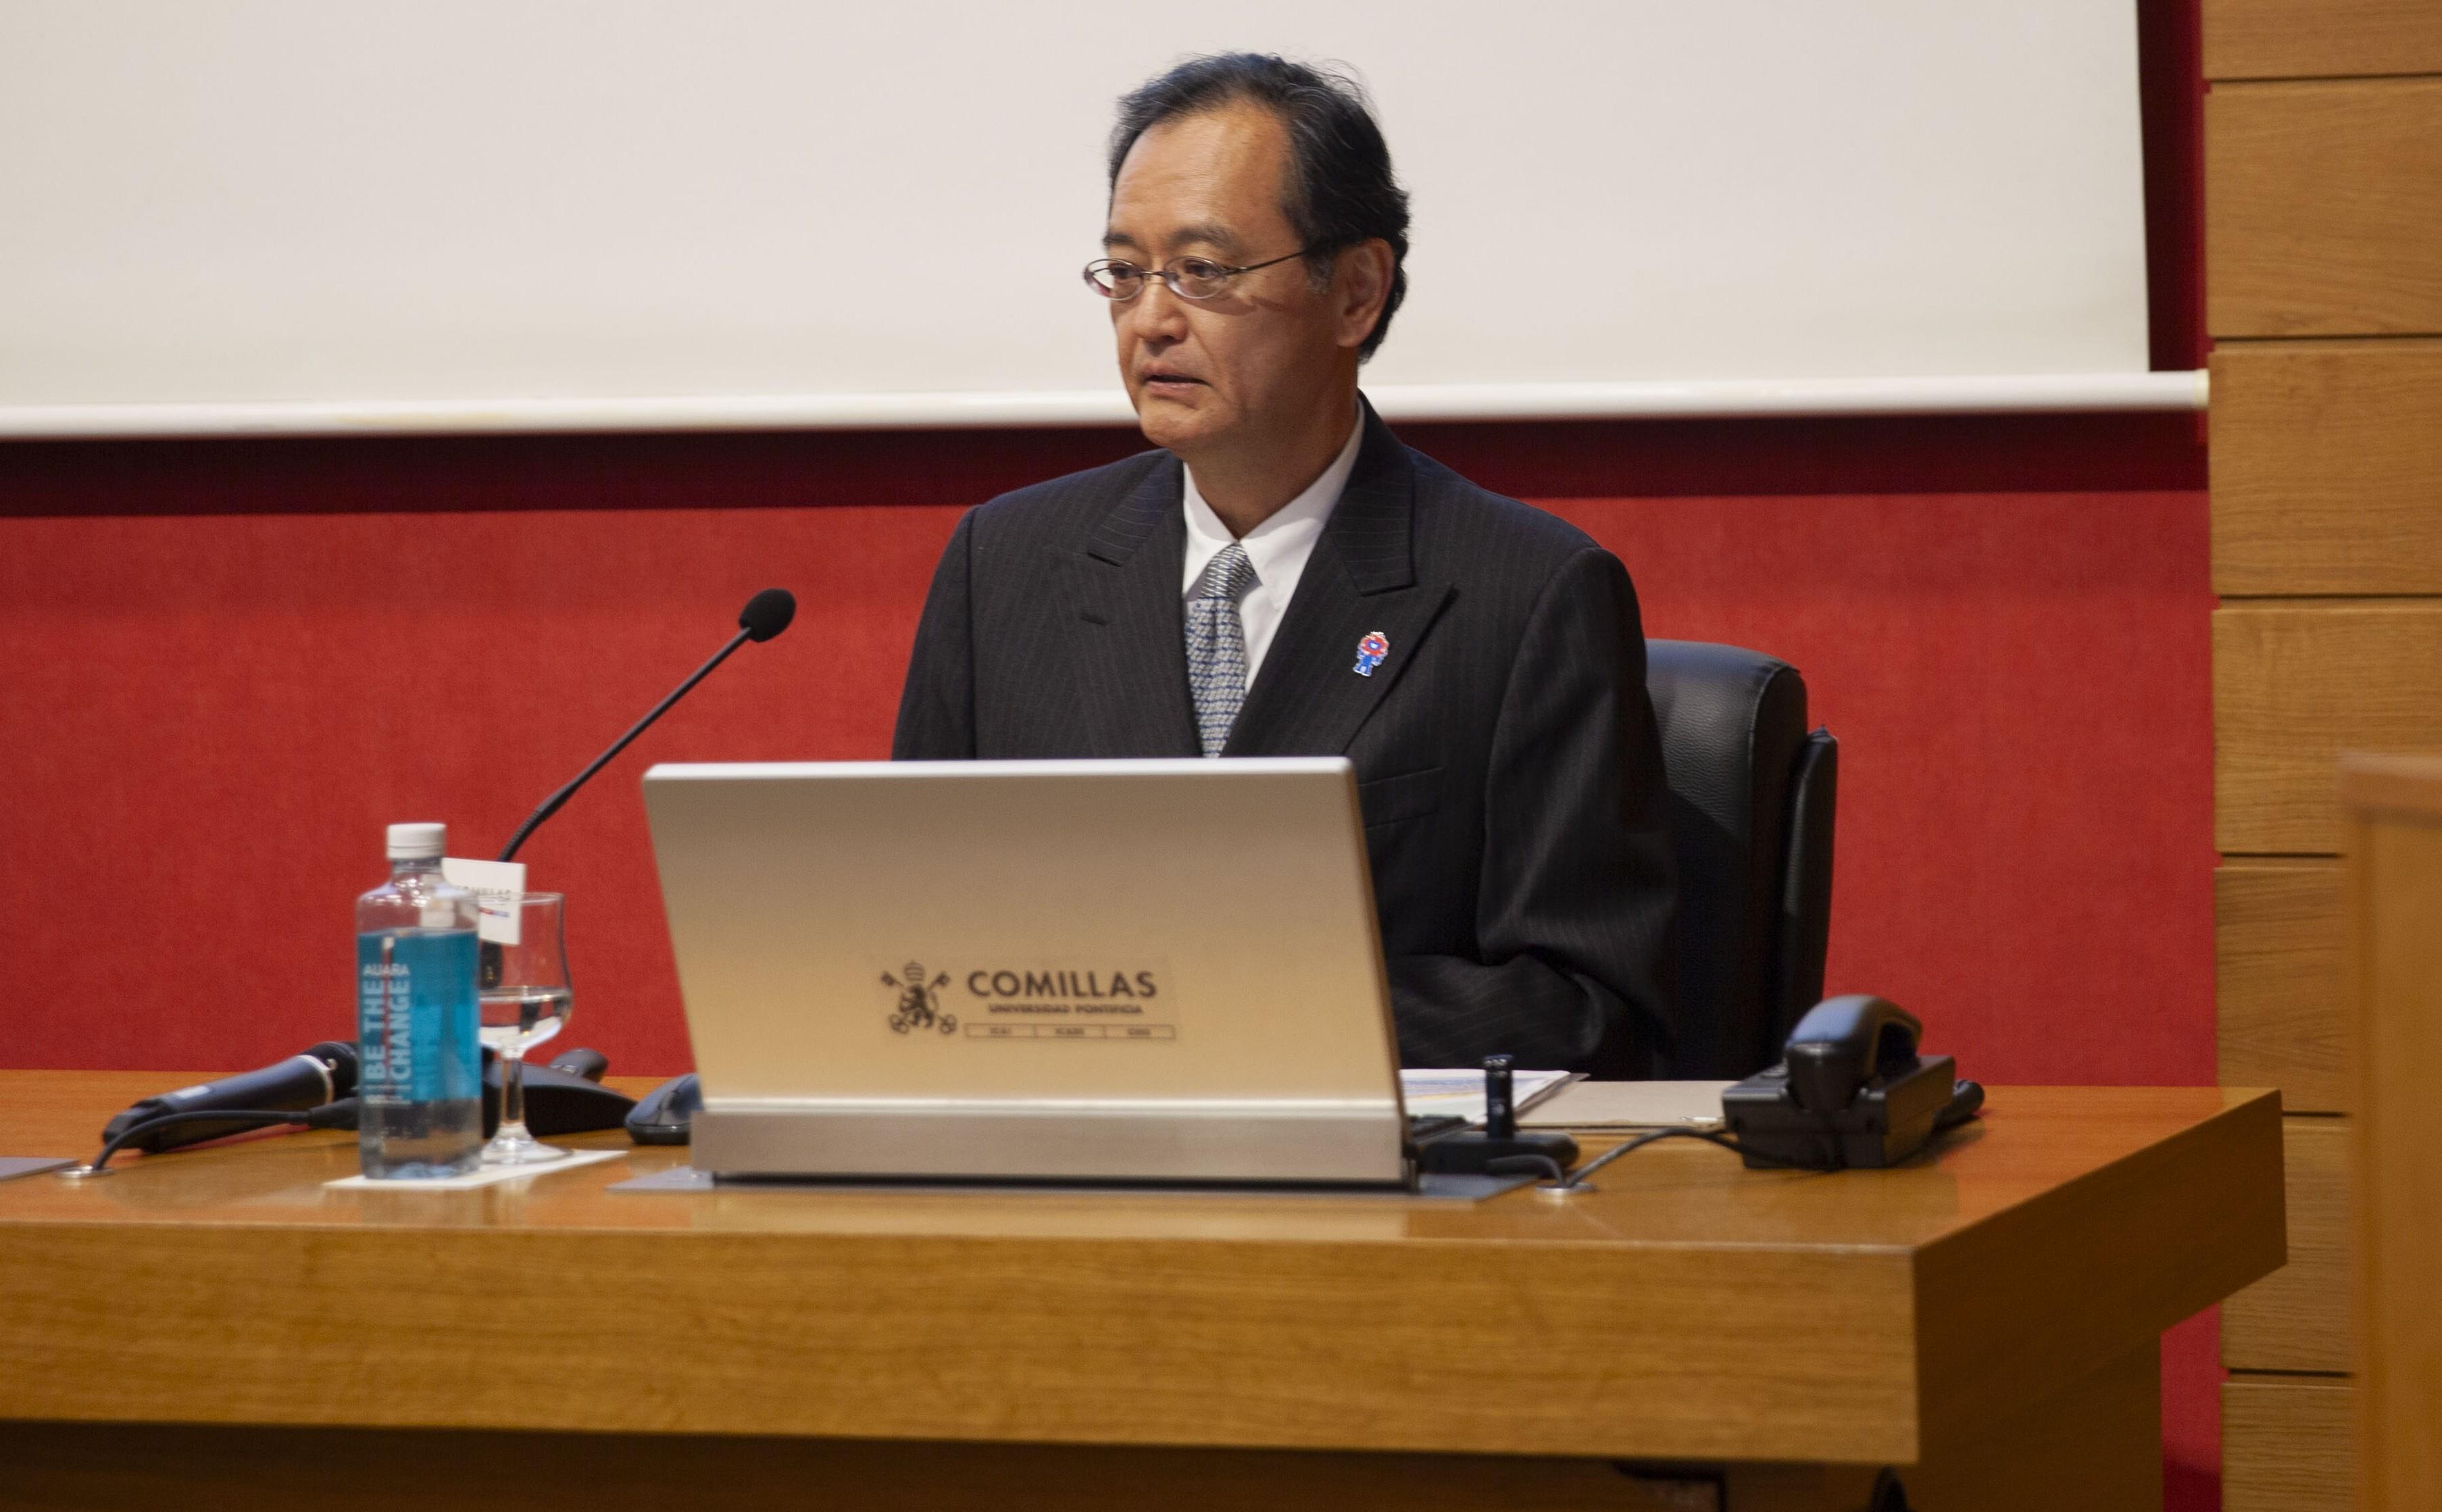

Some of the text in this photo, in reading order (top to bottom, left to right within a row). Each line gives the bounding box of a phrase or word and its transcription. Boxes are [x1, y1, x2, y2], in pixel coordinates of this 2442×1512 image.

[363, 963, 411, 976] AUARA
[966, 970, 1158, 998] COMILLAS
[363, 980, 386, 1080] BE THE
[389, 980, 412, 1080] CHANGE
